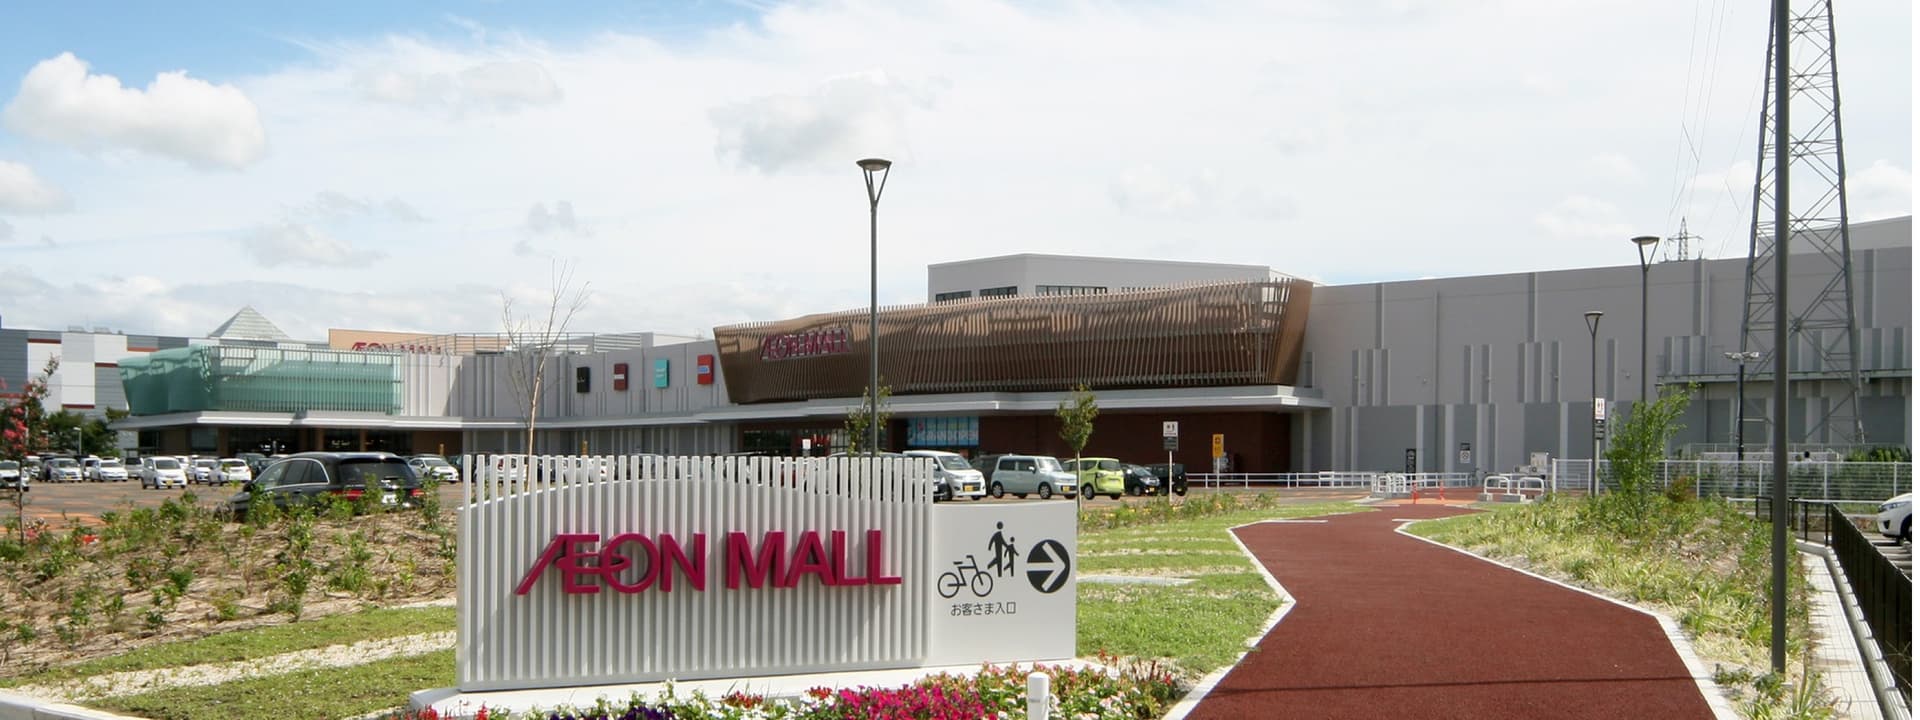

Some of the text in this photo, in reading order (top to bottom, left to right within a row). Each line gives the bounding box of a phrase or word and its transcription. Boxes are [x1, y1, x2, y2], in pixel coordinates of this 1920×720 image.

[725, 529, 902, 589] MALL
[950, 601, 1017, 617] お客さま入口
